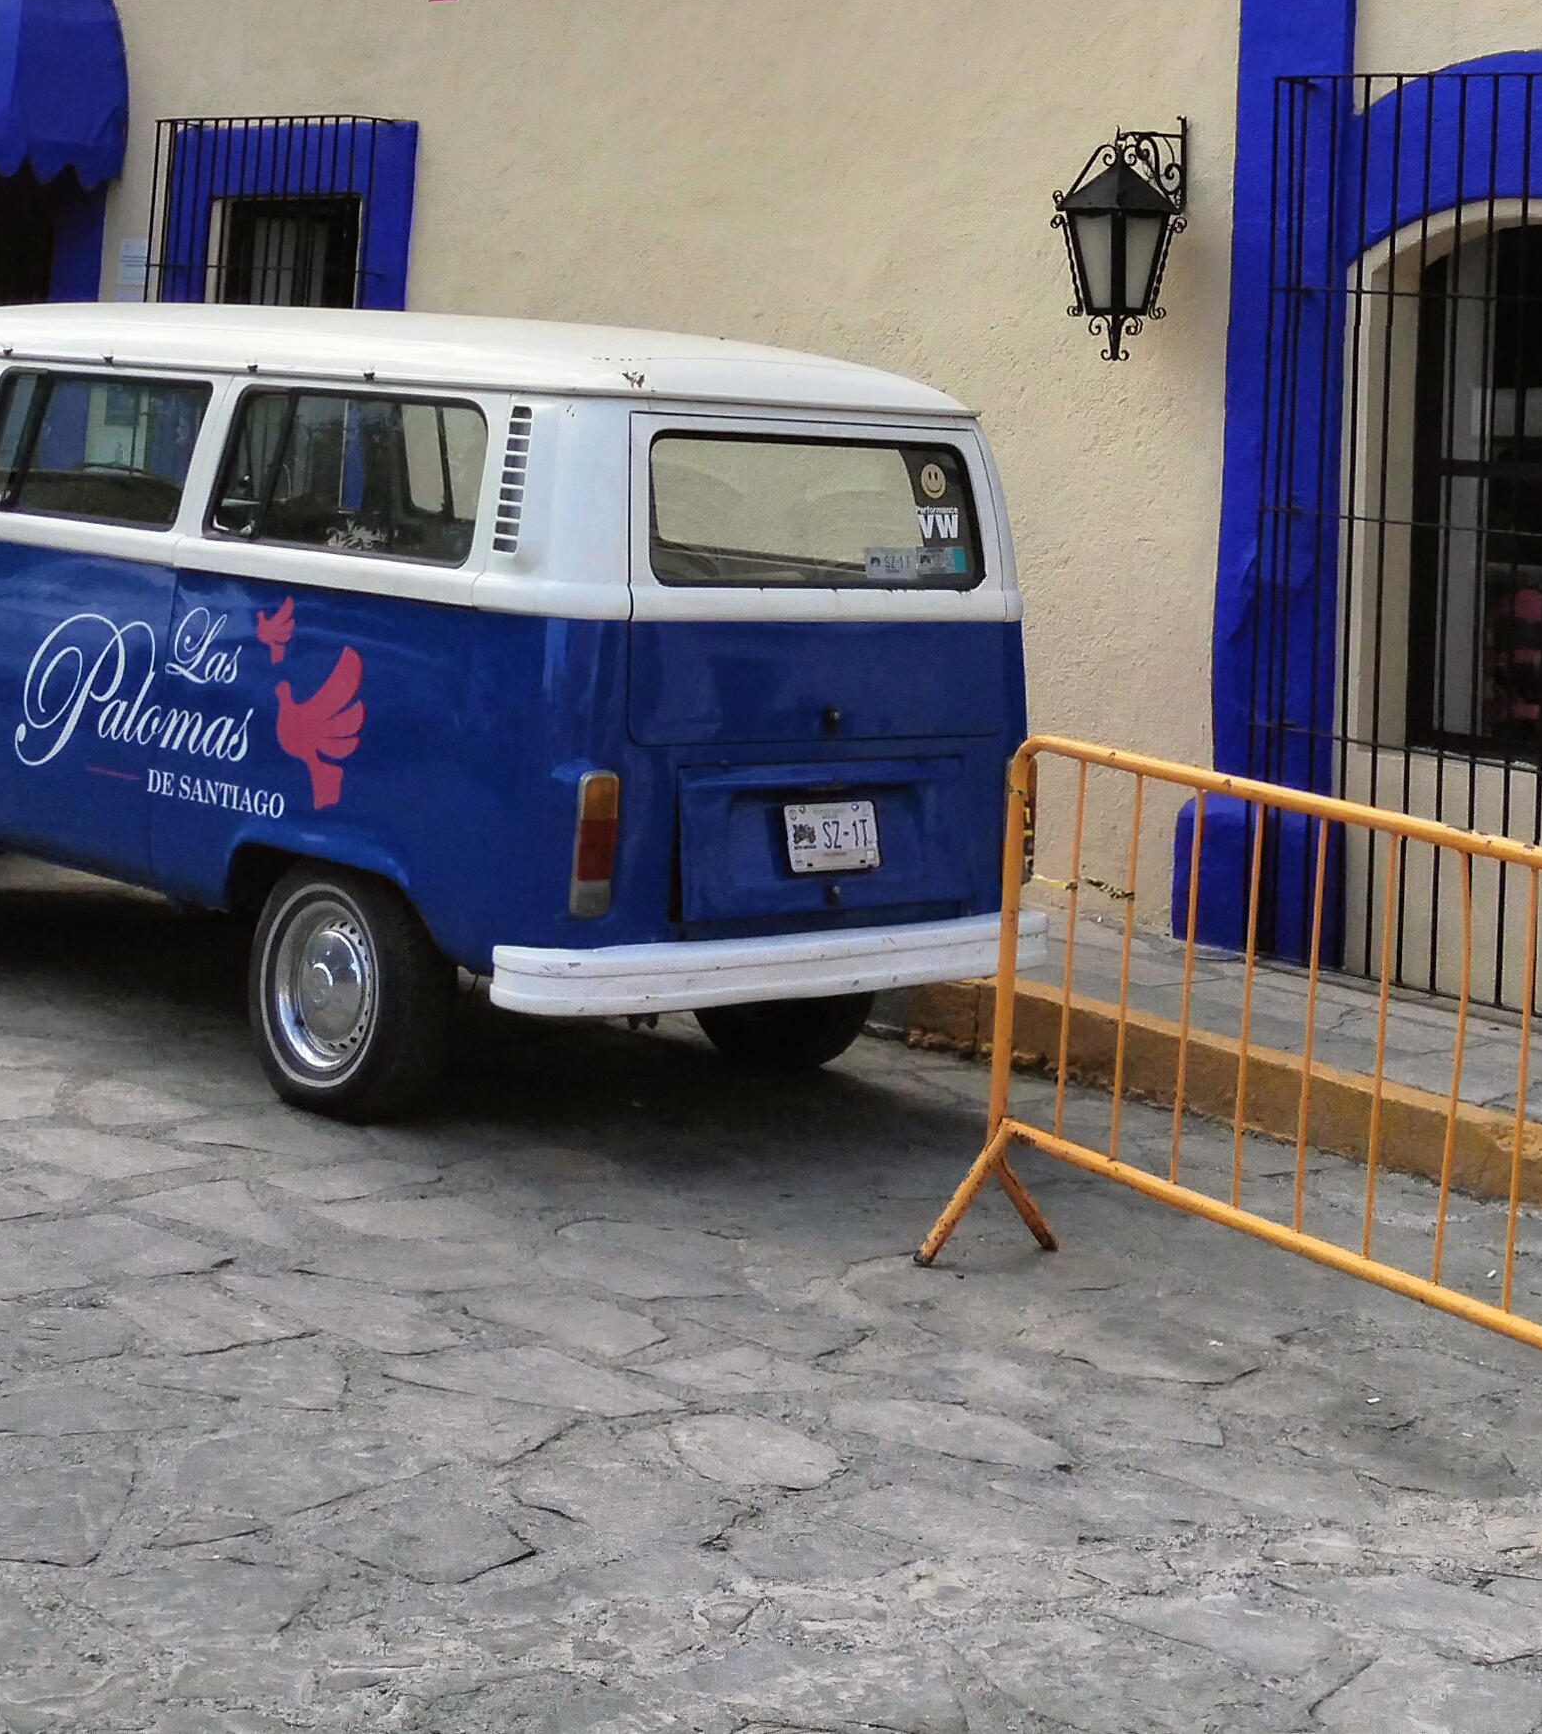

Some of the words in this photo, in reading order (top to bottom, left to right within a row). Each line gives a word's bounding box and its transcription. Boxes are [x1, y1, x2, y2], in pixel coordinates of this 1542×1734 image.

[916, 505, 959, 515] Performance
[917, 514, 959, 539] VW
[165, 606, 243, 684] Las
[14, 611, 255, 767] Palomas
[147, 768, 175, 798] DE
[178, 776, 287, 820] SANTIAGO
[822, 818, 868, 849] SZ-1T
